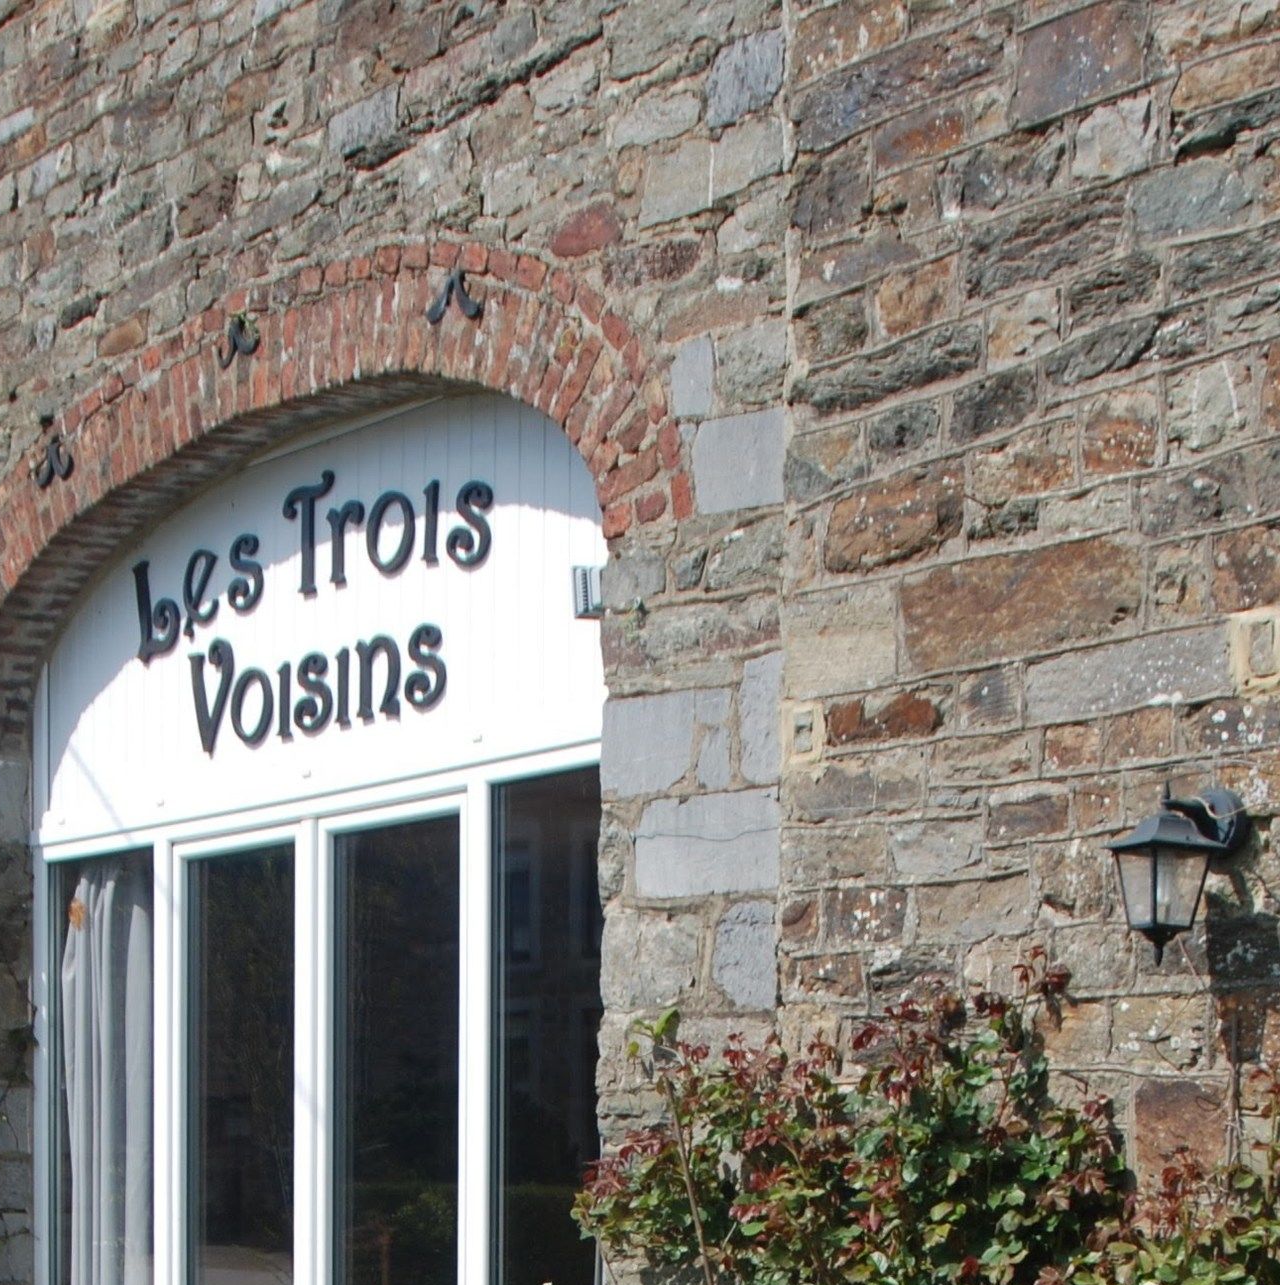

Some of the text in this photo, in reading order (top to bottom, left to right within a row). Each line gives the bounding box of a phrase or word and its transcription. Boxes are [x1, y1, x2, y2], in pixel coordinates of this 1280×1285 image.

[132, 470, 495, 664] Les Trois
[188, 623, 448, 758] Voisins
